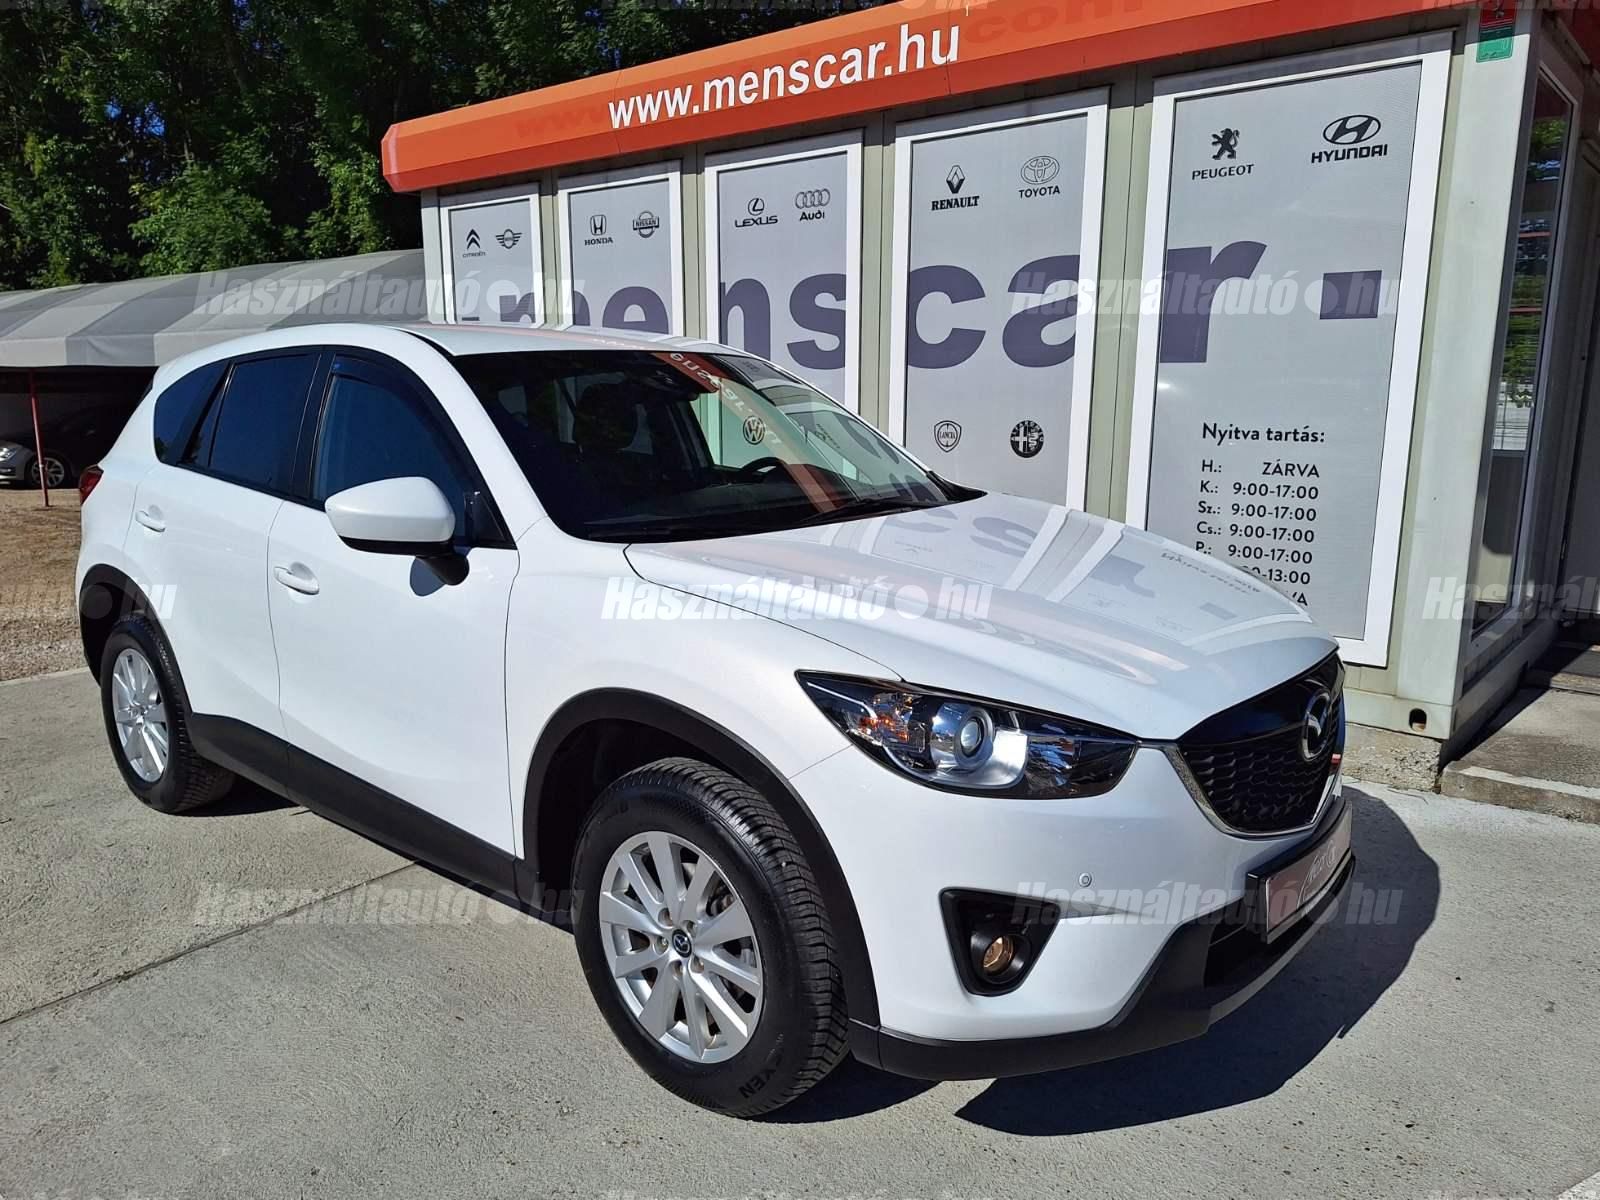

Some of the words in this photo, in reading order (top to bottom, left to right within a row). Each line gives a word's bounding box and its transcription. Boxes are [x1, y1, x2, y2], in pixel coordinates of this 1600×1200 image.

[608, 23, 961, 129] www.menscar.hu
[1311, 143, 1388, 163] HYUNDAI
[1191, 164, 1254, 180] PEUGEOT
[1018, 186, 1061, 199] TOYOTA
[931, 196, 980, 211] RENAULT
[635, 218, 657, 227] NISSAN
[734, 215, 778, 228] LEXUS
[799, 210, 825, 221] Audi
[584, 237, 614, 246] HONDA
[1202, 422, 1260, 446] Nyitva
[1266, 425, 1325, 443] tartás:
[1201, 459, 1222, 473] H.:
[1262, 459, 1320, 478] ZÁRVA
[1200, 480, 1218, 494] K.:
[1233, 482, 1319, 500] 9:00-17:00
[1198, 501, 1221, 515] Sz.:
[1231, 503, 1317, 522] 9:00-17:00
[1196, 521, 1221, 536] Cs.:
[1229, 523, 1315, 543] 9:00-17:00
[1195, 541, 1212, 555] P.:
[1227, 544, 1313, 564] 9:00-17:00
